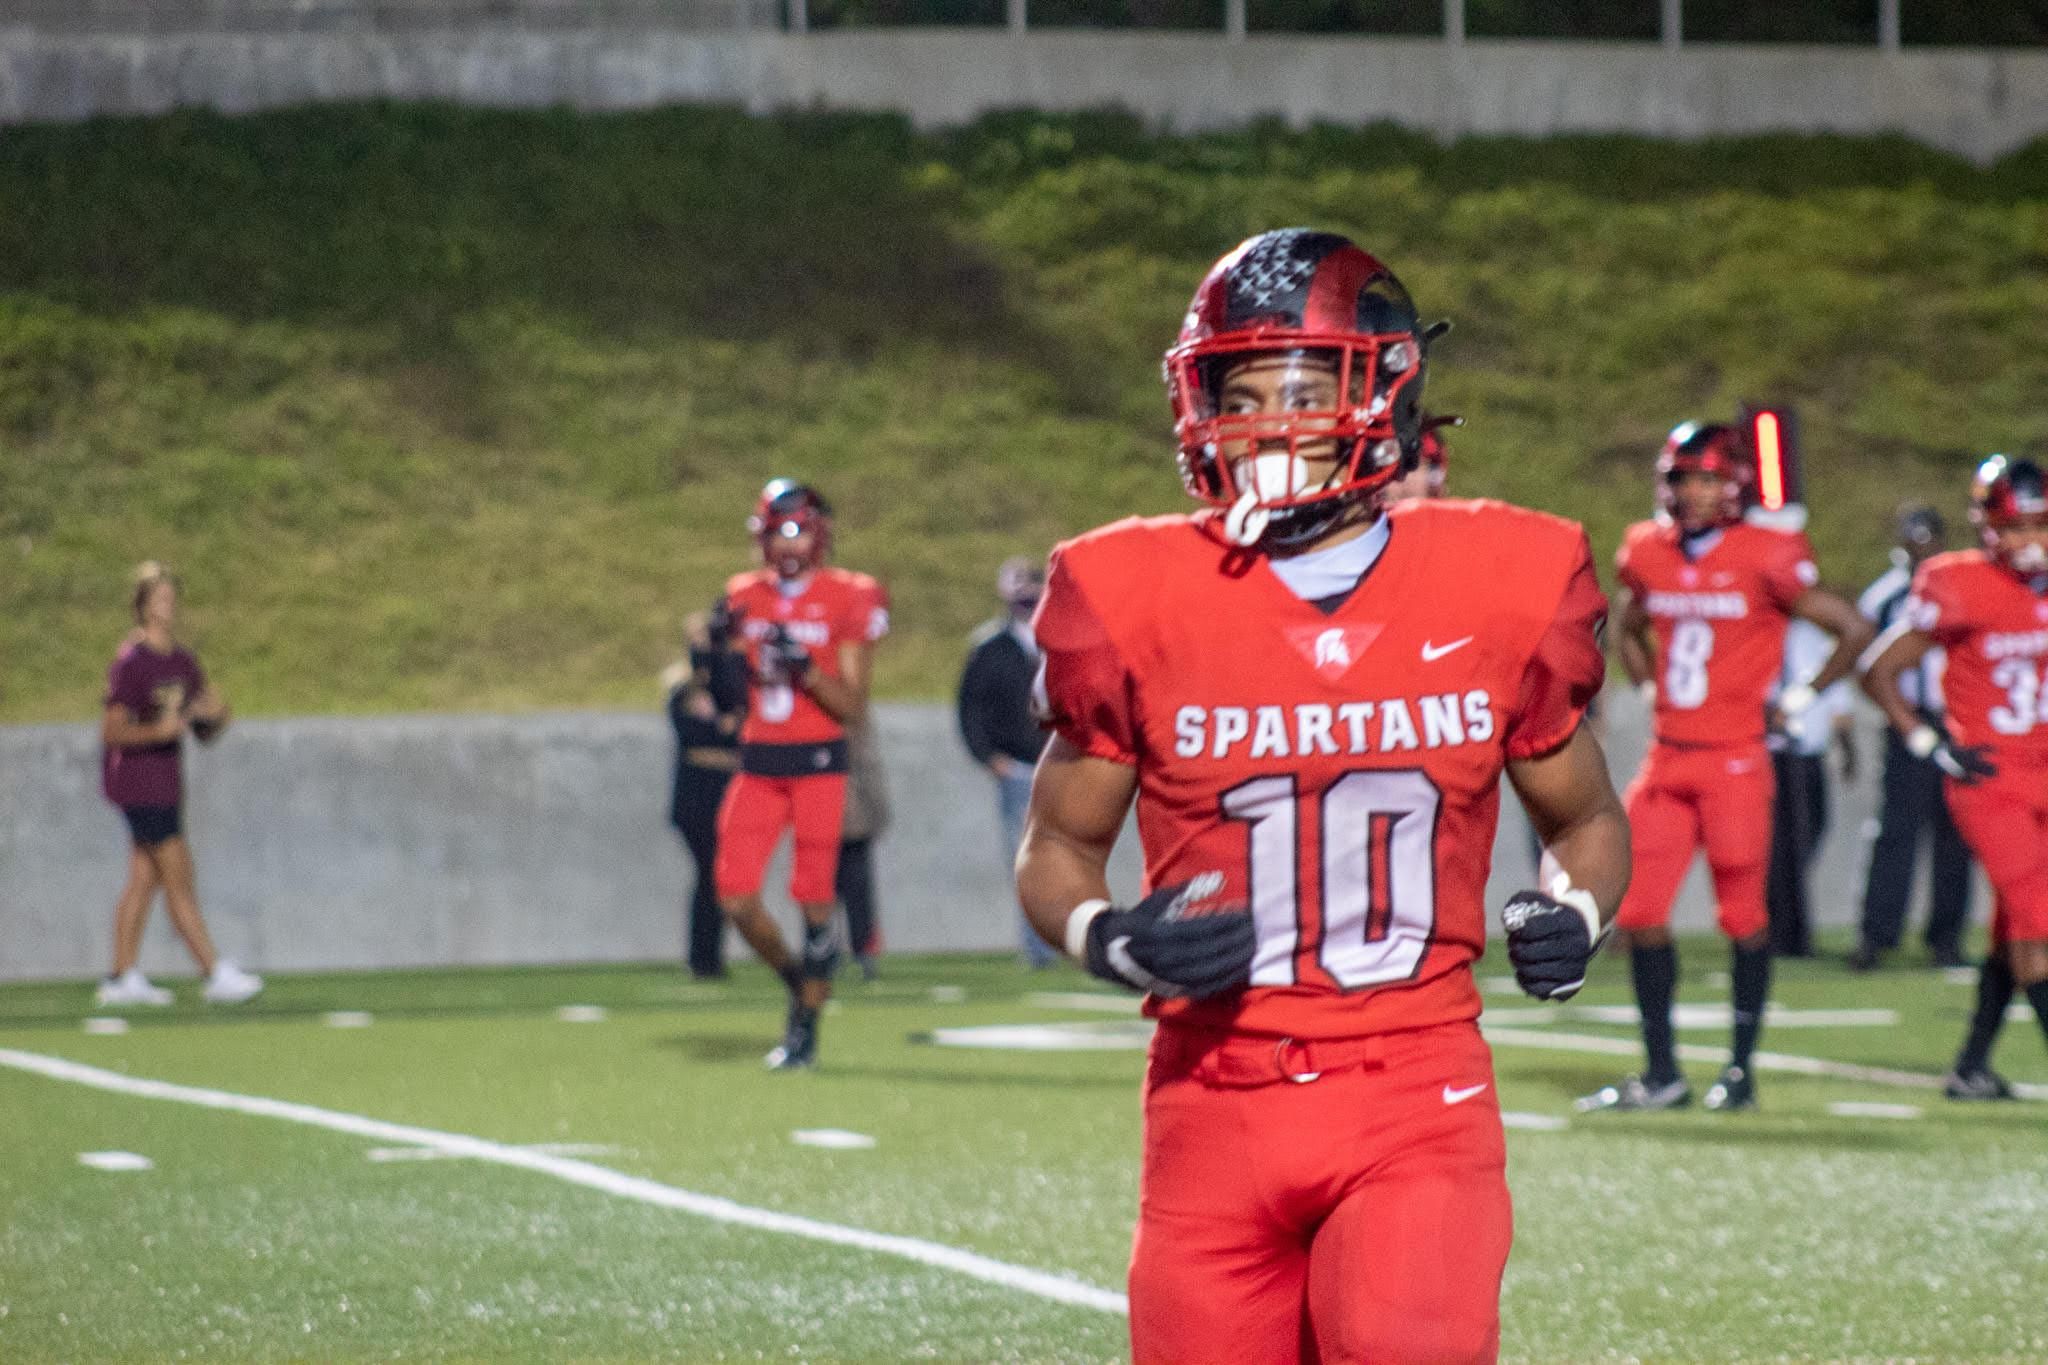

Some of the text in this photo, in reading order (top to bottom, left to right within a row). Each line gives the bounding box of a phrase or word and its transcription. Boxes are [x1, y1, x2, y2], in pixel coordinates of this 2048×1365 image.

[1667, 620, 1714, 710] 8
[1987, 656, 2048, 735] 3
[1174, 689, 1494, 759] SPARTANS
[1220, 768, 1443, 990] 10
